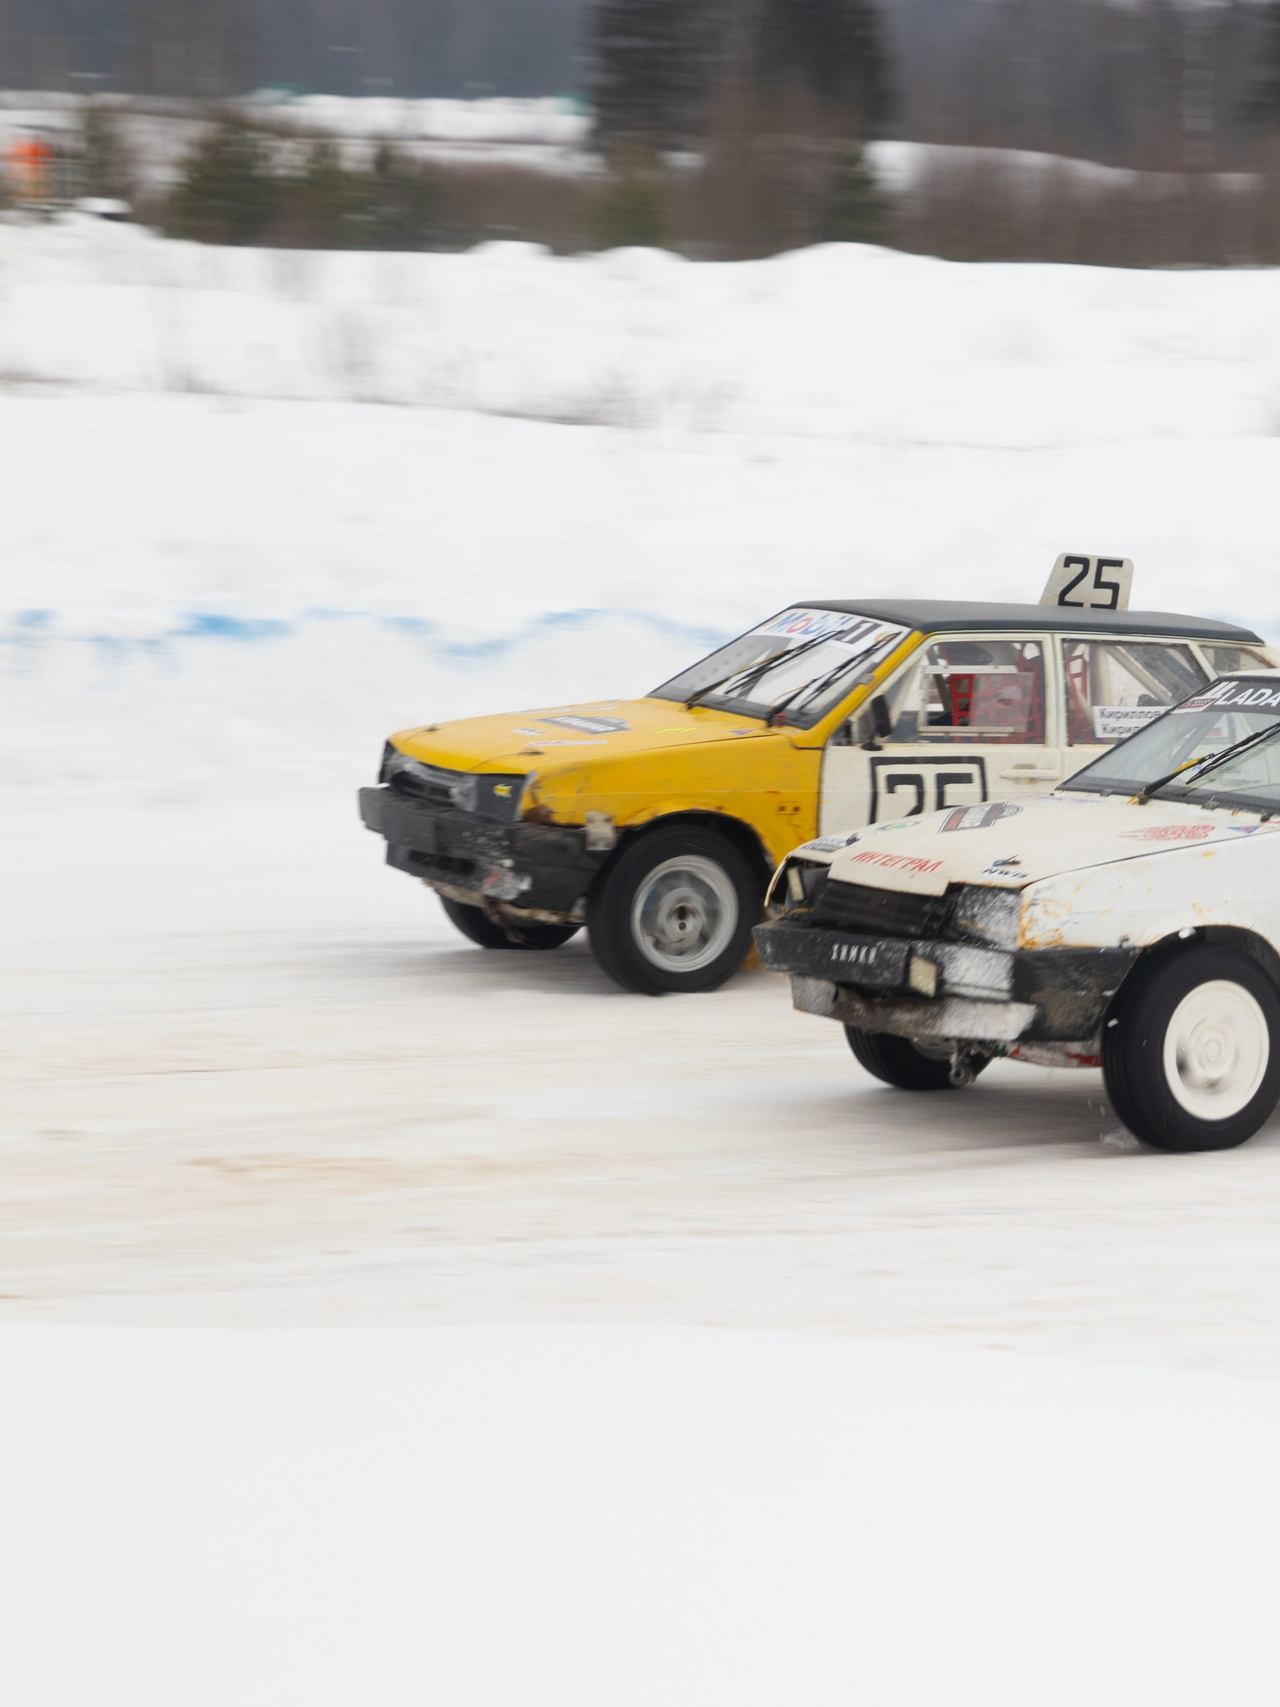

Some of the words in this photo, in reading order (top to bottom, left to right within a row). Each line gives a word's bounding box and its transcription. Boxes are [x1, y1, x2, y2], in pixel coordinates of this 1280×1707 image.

[1058, 555, 1124, 610] 25
[833, 619, 883, 645] 1
[1099, 708, 1161, 721] Кириллов
[851, 851, 945, 873] ИНТЕГРАЛ
